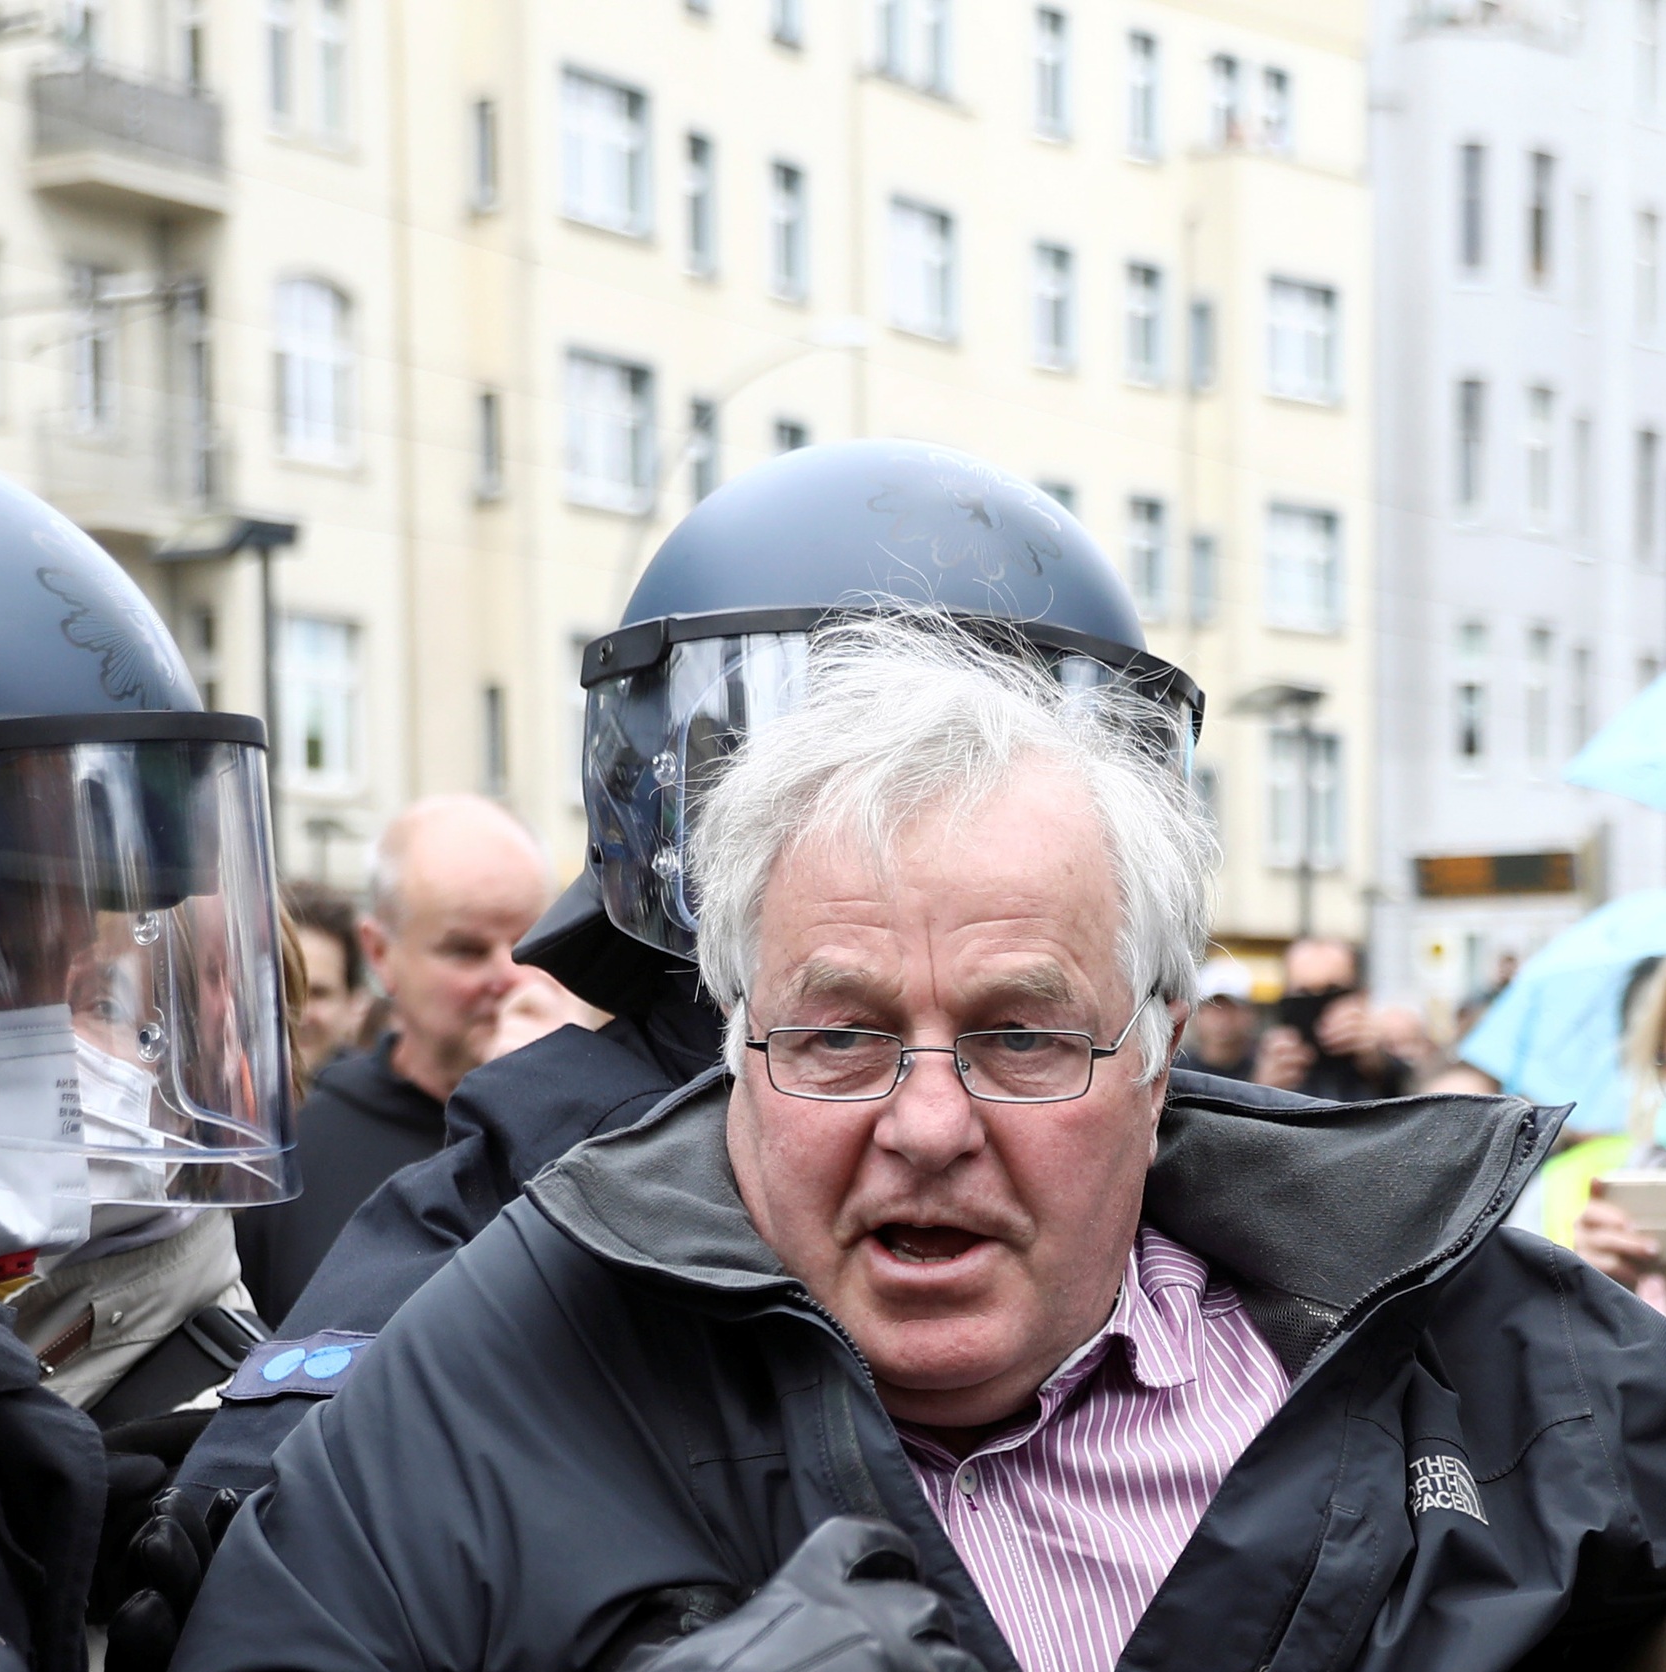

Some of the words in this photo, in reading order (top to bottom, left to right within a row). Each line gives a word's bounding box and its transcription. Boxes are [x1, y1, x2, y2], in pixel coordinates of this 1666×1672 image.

[1409, 1455, 1457, 1476] THE
[1409, 1473, 1460, 1505] ORTH
[1414, 1491, 1466, 1517] FACE
